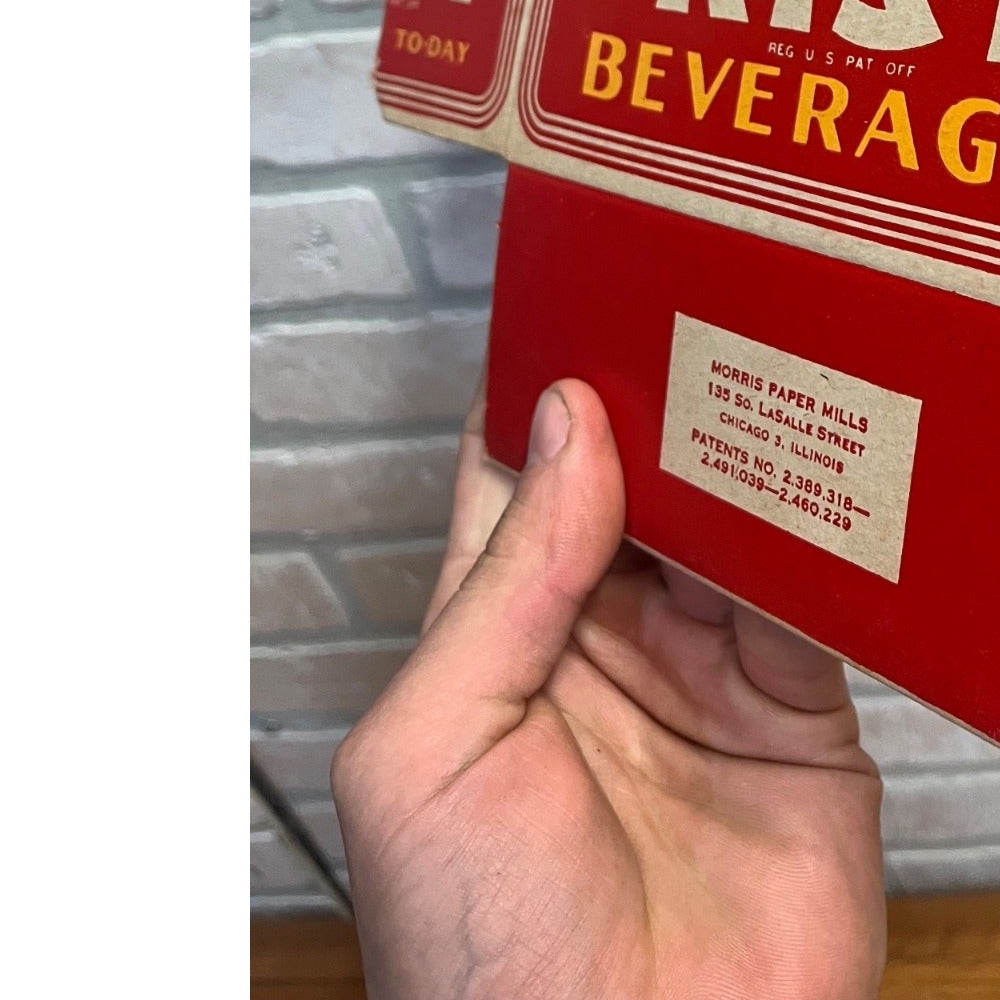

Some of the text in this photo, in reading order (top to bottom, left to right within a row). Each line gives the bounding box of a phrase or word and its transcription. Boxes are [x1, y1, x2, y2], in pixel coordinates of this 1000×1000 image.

[768, 42, 916, 78] REG U S PAT OFF
[708, 381, 731, 401] 135
[817, 426, 866, 457] STREET
[711, 360, 868, 433] MORRIS PAPER MILLS
[691, 428, 749, 464] PATENTS
[720, 412, 770, 442] CHICAGO
[791, 441, 845, 474] ILLINOIS
